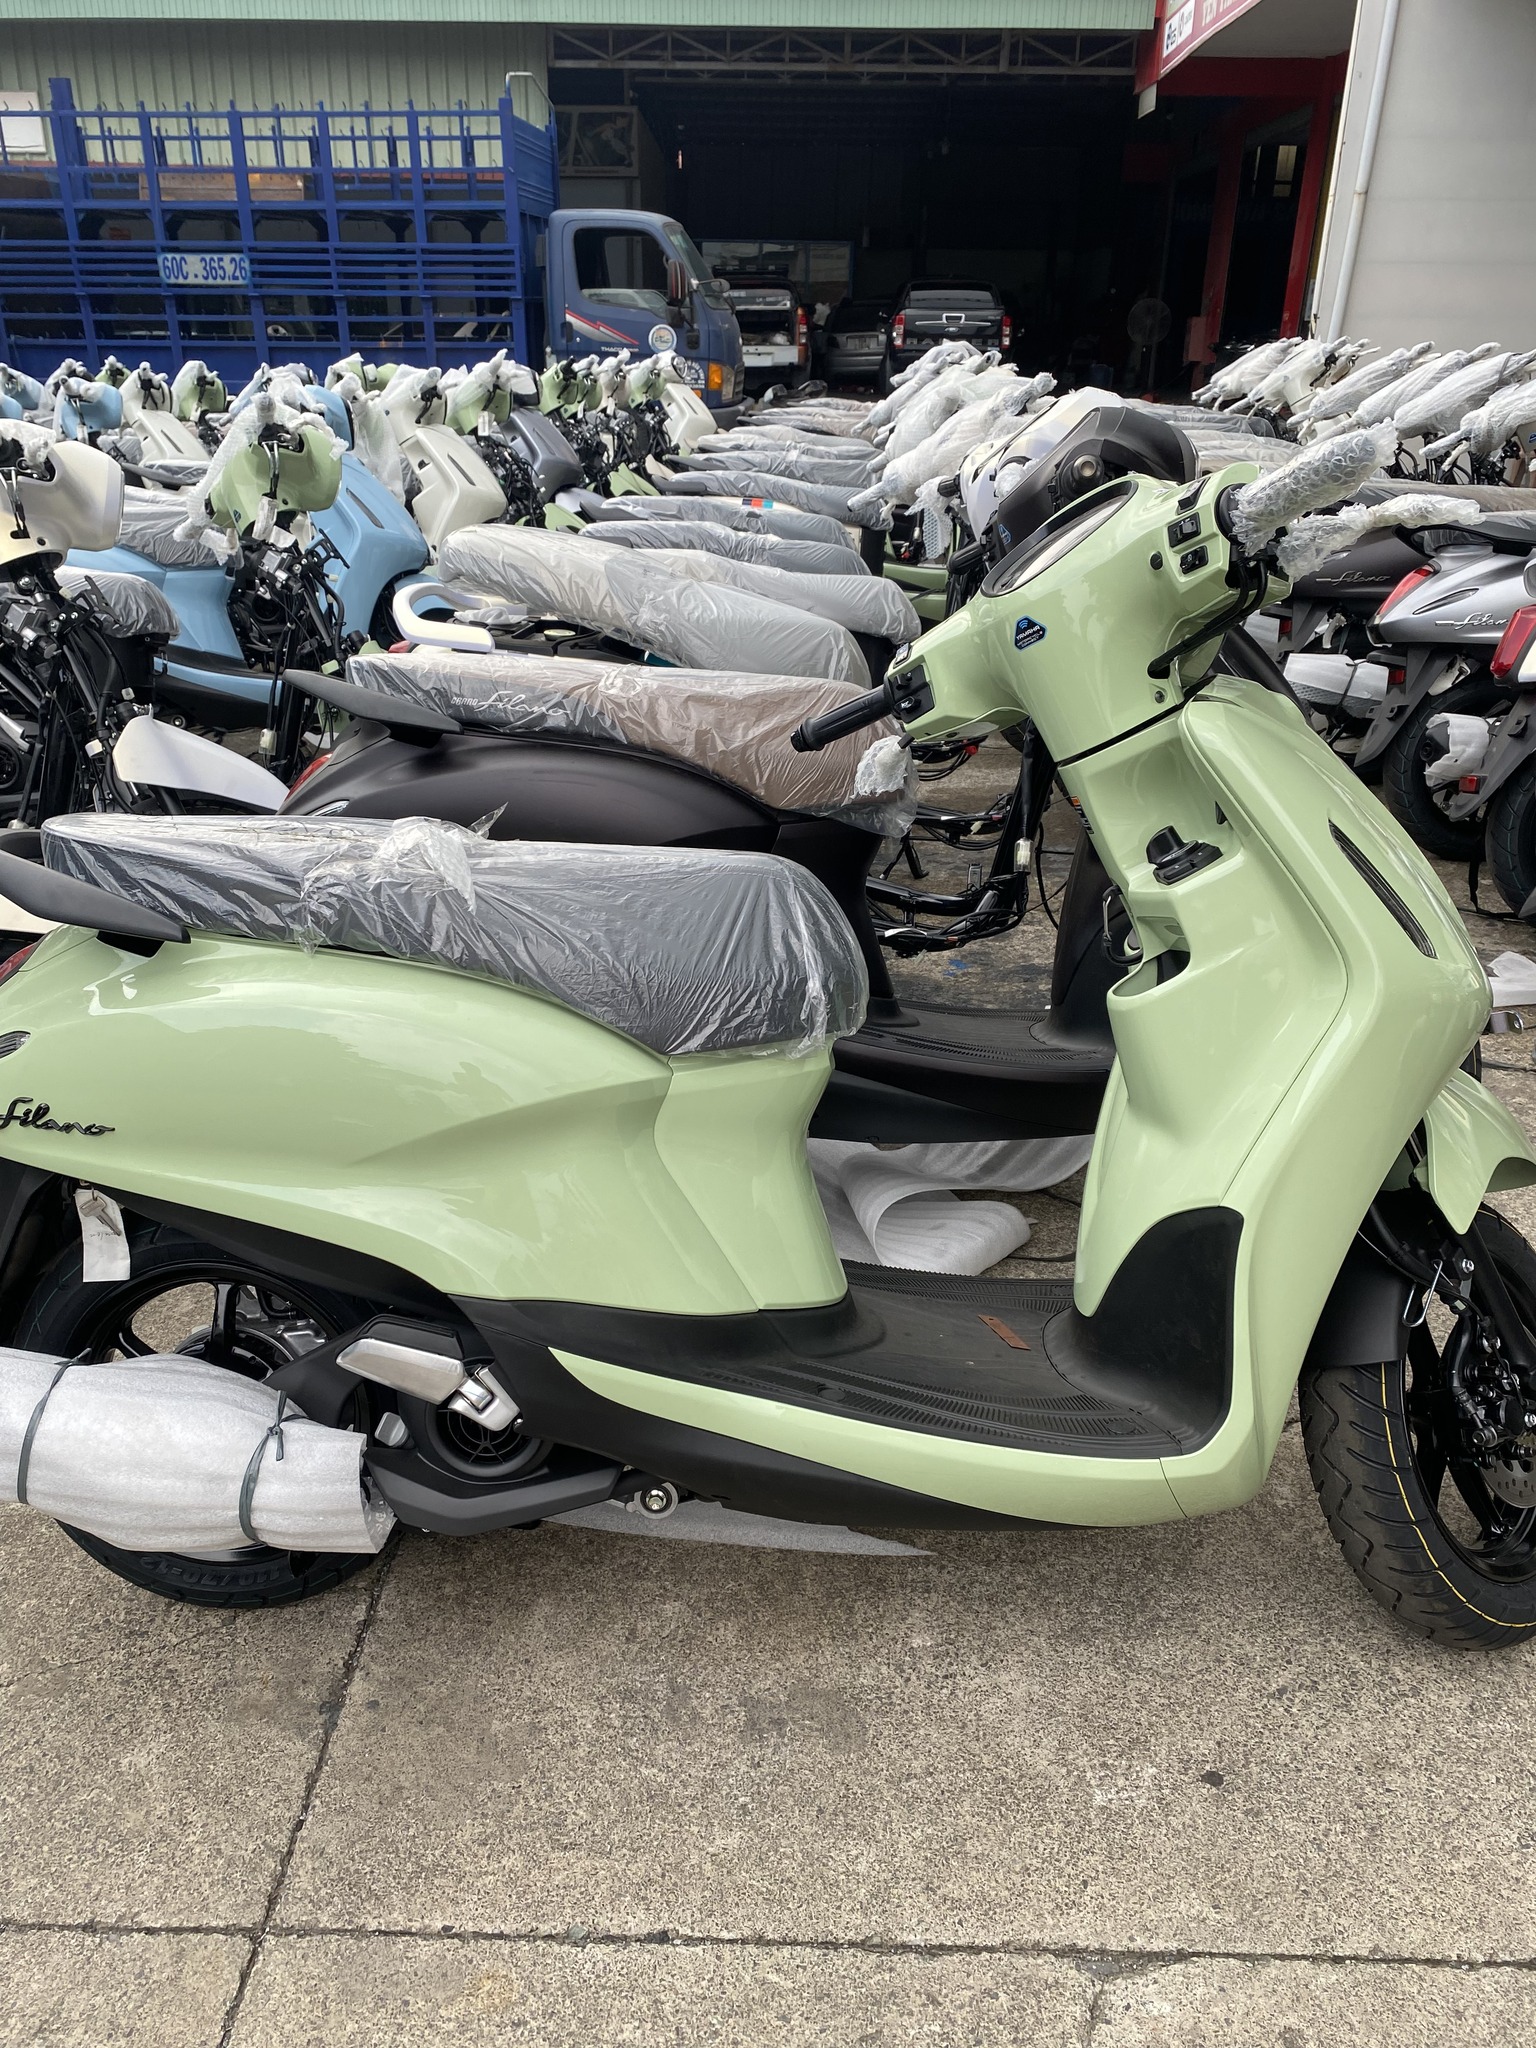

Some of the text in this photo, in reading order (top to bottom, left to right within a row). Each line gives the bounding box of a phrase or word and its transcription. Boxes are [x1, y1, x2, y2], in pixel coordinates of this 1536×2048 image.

[1332, 570, 1391, 586] Filano
[1454, 612, 1509, 630] Filan
[1016, 624, 1040, 640] YAMAHA
[474, 691, 571, 716] Filano
[0, 1096, 115, 1136] Filano
